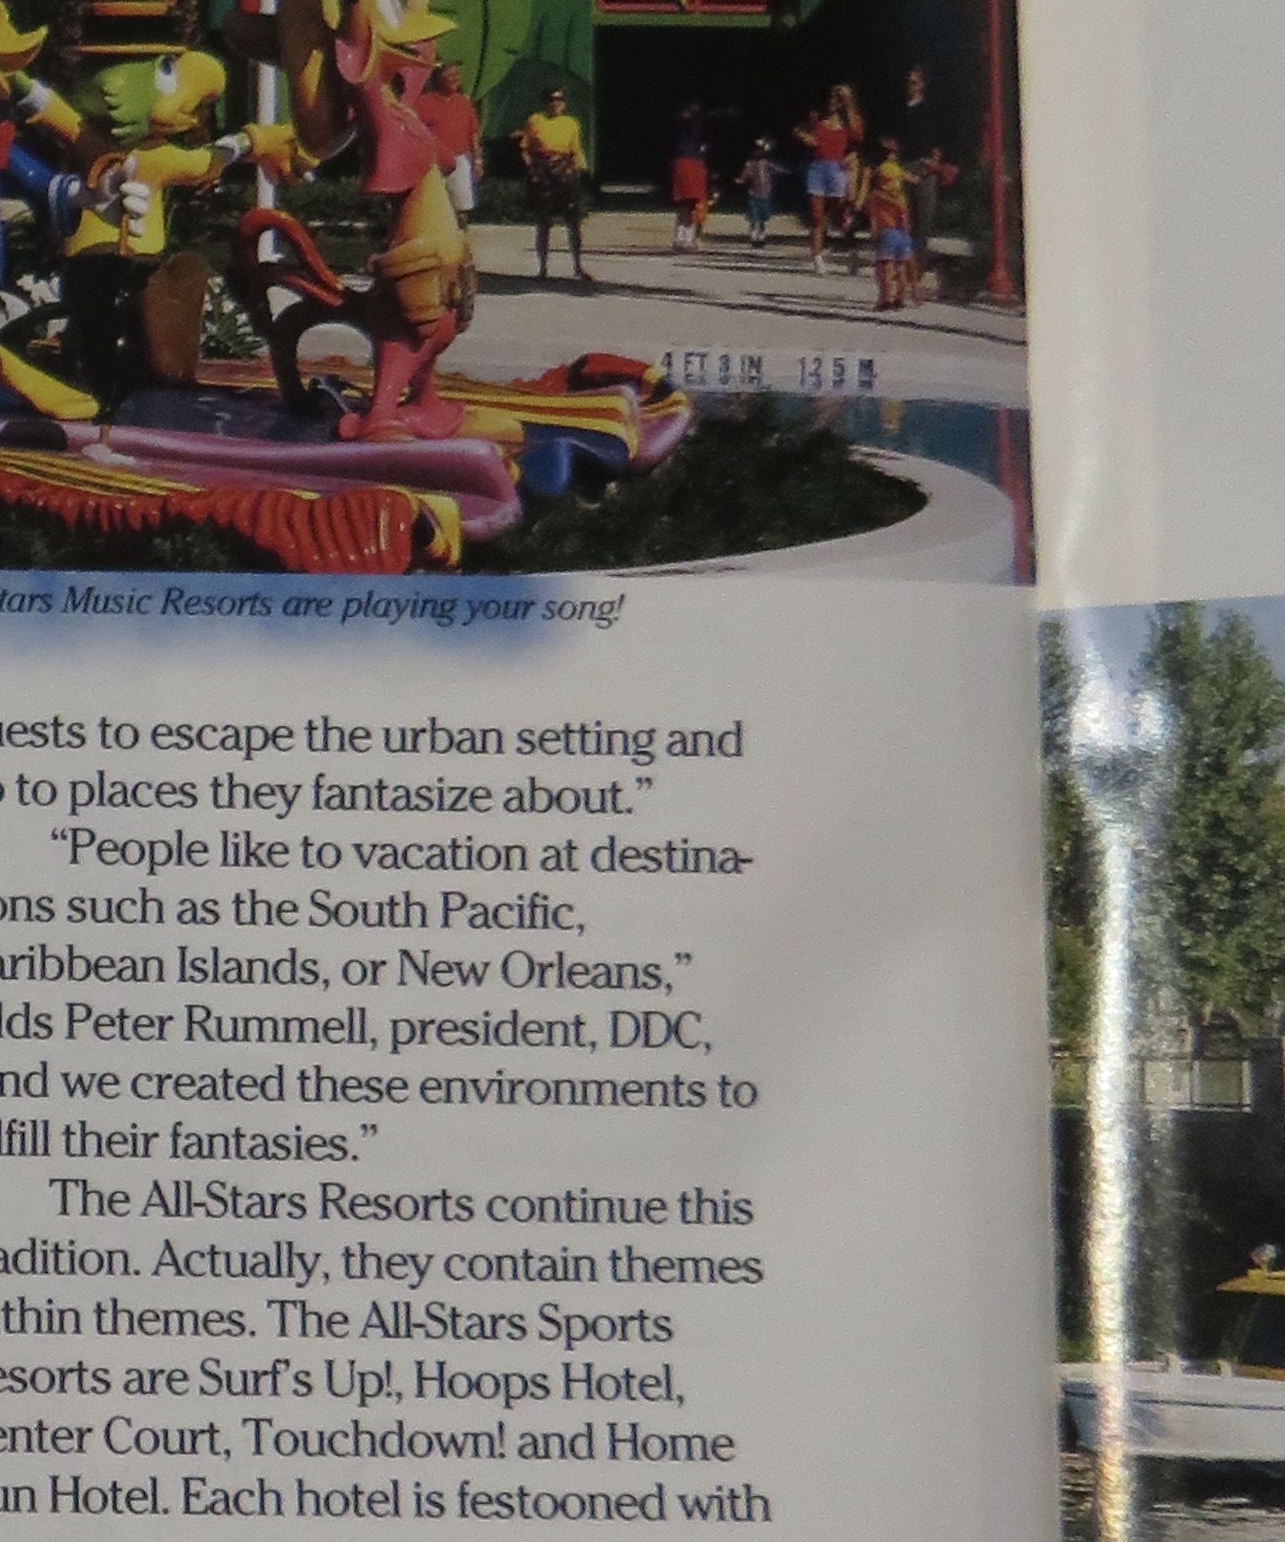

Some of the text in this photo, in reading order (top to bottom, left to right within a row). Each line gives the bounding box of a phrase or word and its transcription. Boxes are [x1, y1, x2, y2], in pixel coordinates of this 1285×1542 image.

[62, 586, 152, 615] Music
[160, 587, 271, 616] Resorts
[282, 593, 333, 618] are
[340, 590, 459, 627] playing
[460, 595, 536, 627] your
[541, 593, 626, 629] song!
[67, 887, 165, 924] such
[177, 898, 221, 925] as
[232, 889, 299, 927] the
[308, 889, 429, 928] South
[440, 891, 585, 936] Pacific,
[49, 1178, 754, 1226] The All-Stars Resorts continue this
[104, 1415, 231, 1461] Court,
[242, 1417, 506, 1459] Touchdown!
[517, 1422, 596, 1460] and
[607, 1422, 735, 1462] Home
